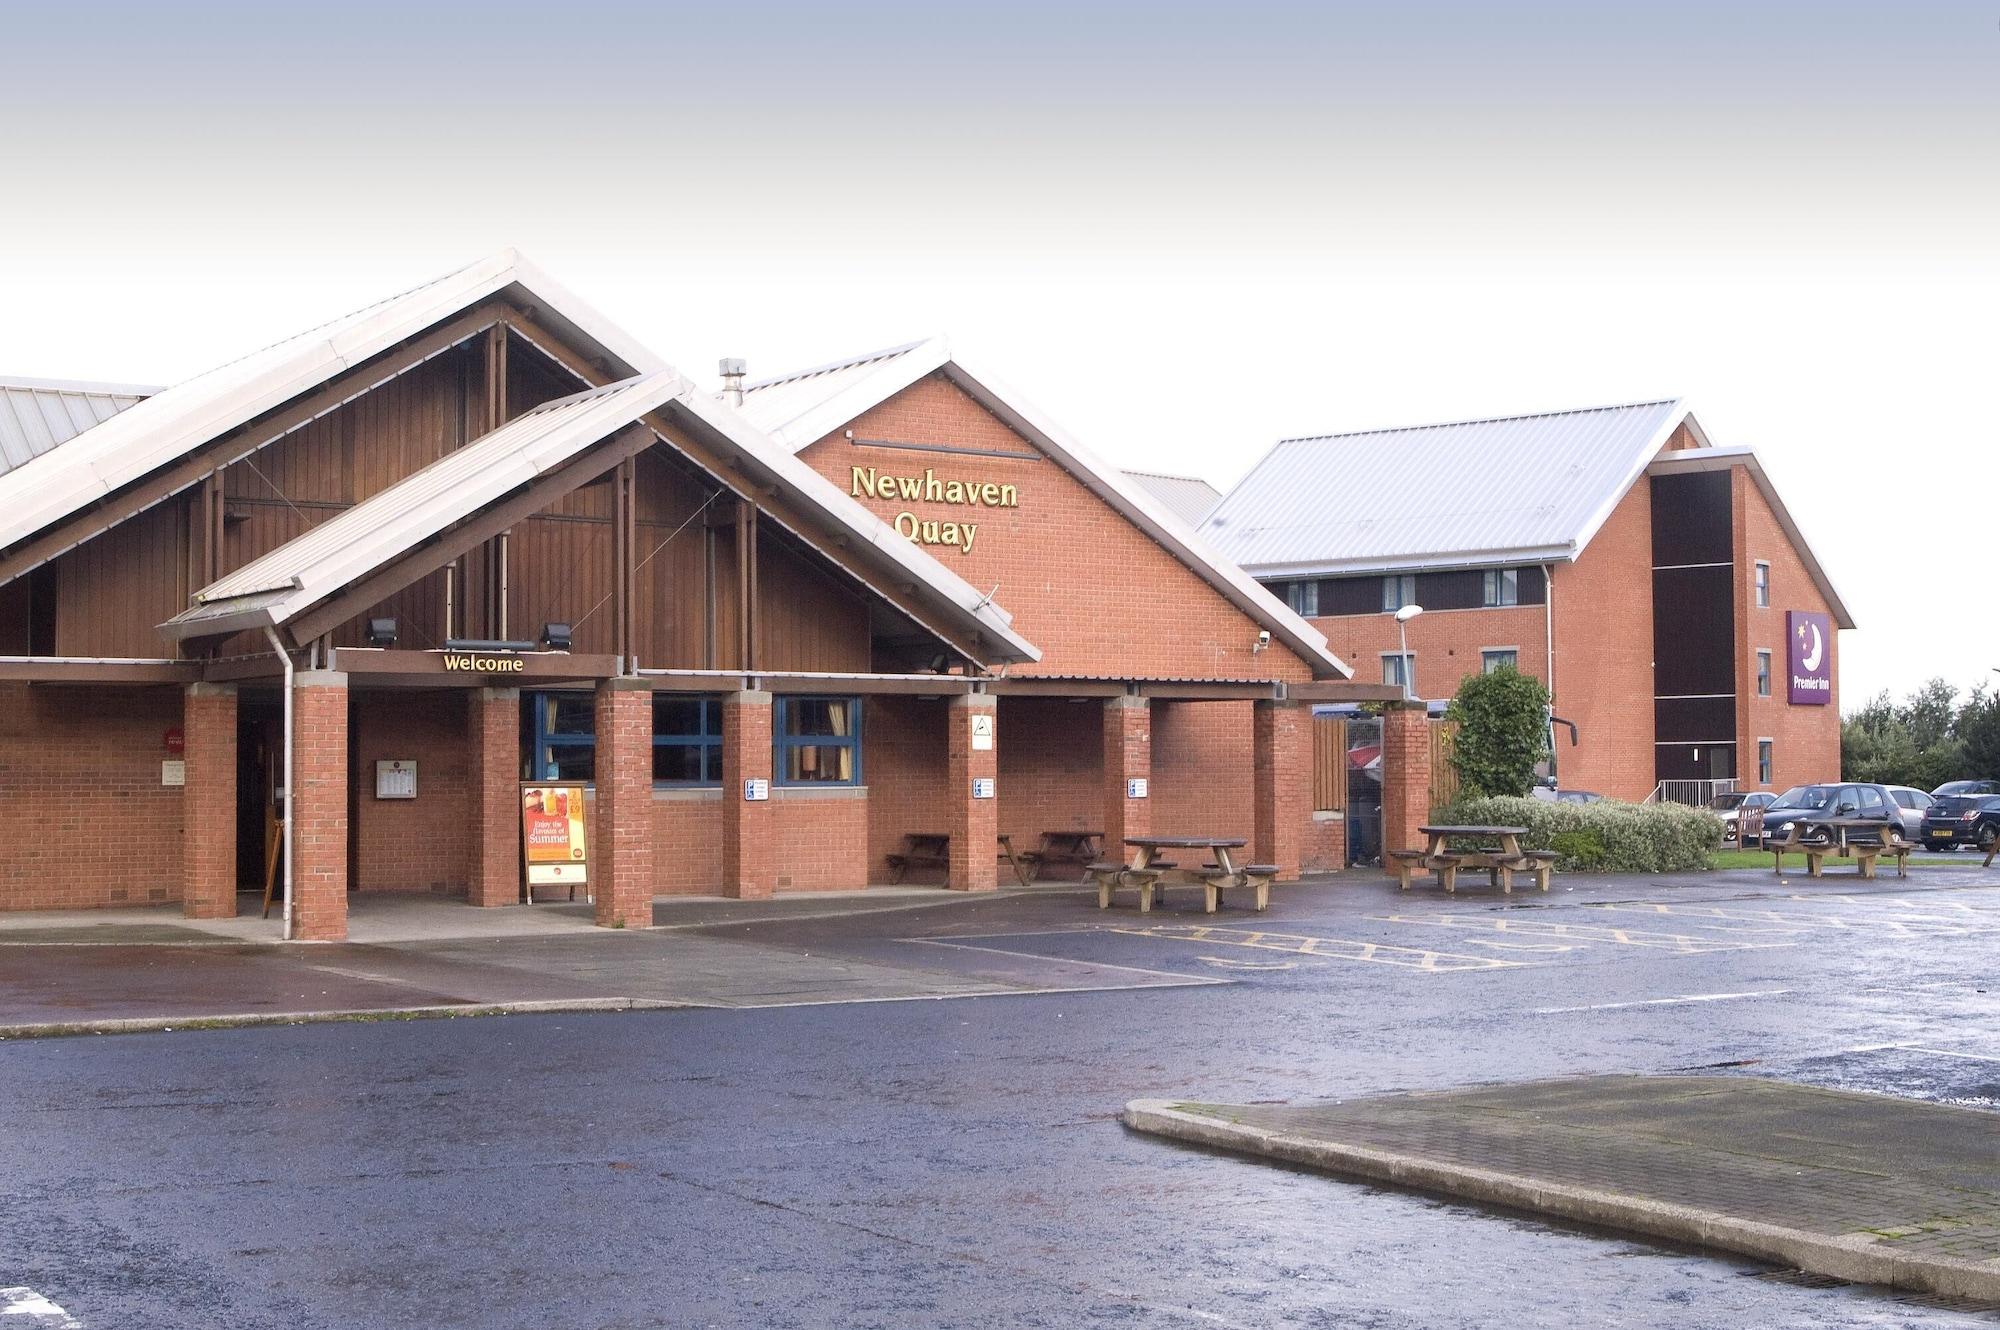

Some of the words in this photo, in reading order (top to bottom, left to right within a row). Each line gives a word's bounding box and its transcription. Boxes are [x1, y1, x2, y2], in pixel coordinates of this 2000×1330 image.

[851, 466, 1018, 507] Newhaven
[894, 511, 977, 554] Quay
[444, 654, 524, 672] Welcome
[1793, 675, 1818, 690] Premier
[1819, 676, 1830, 691] Inn
[529, 833, 569, 844] Summer
